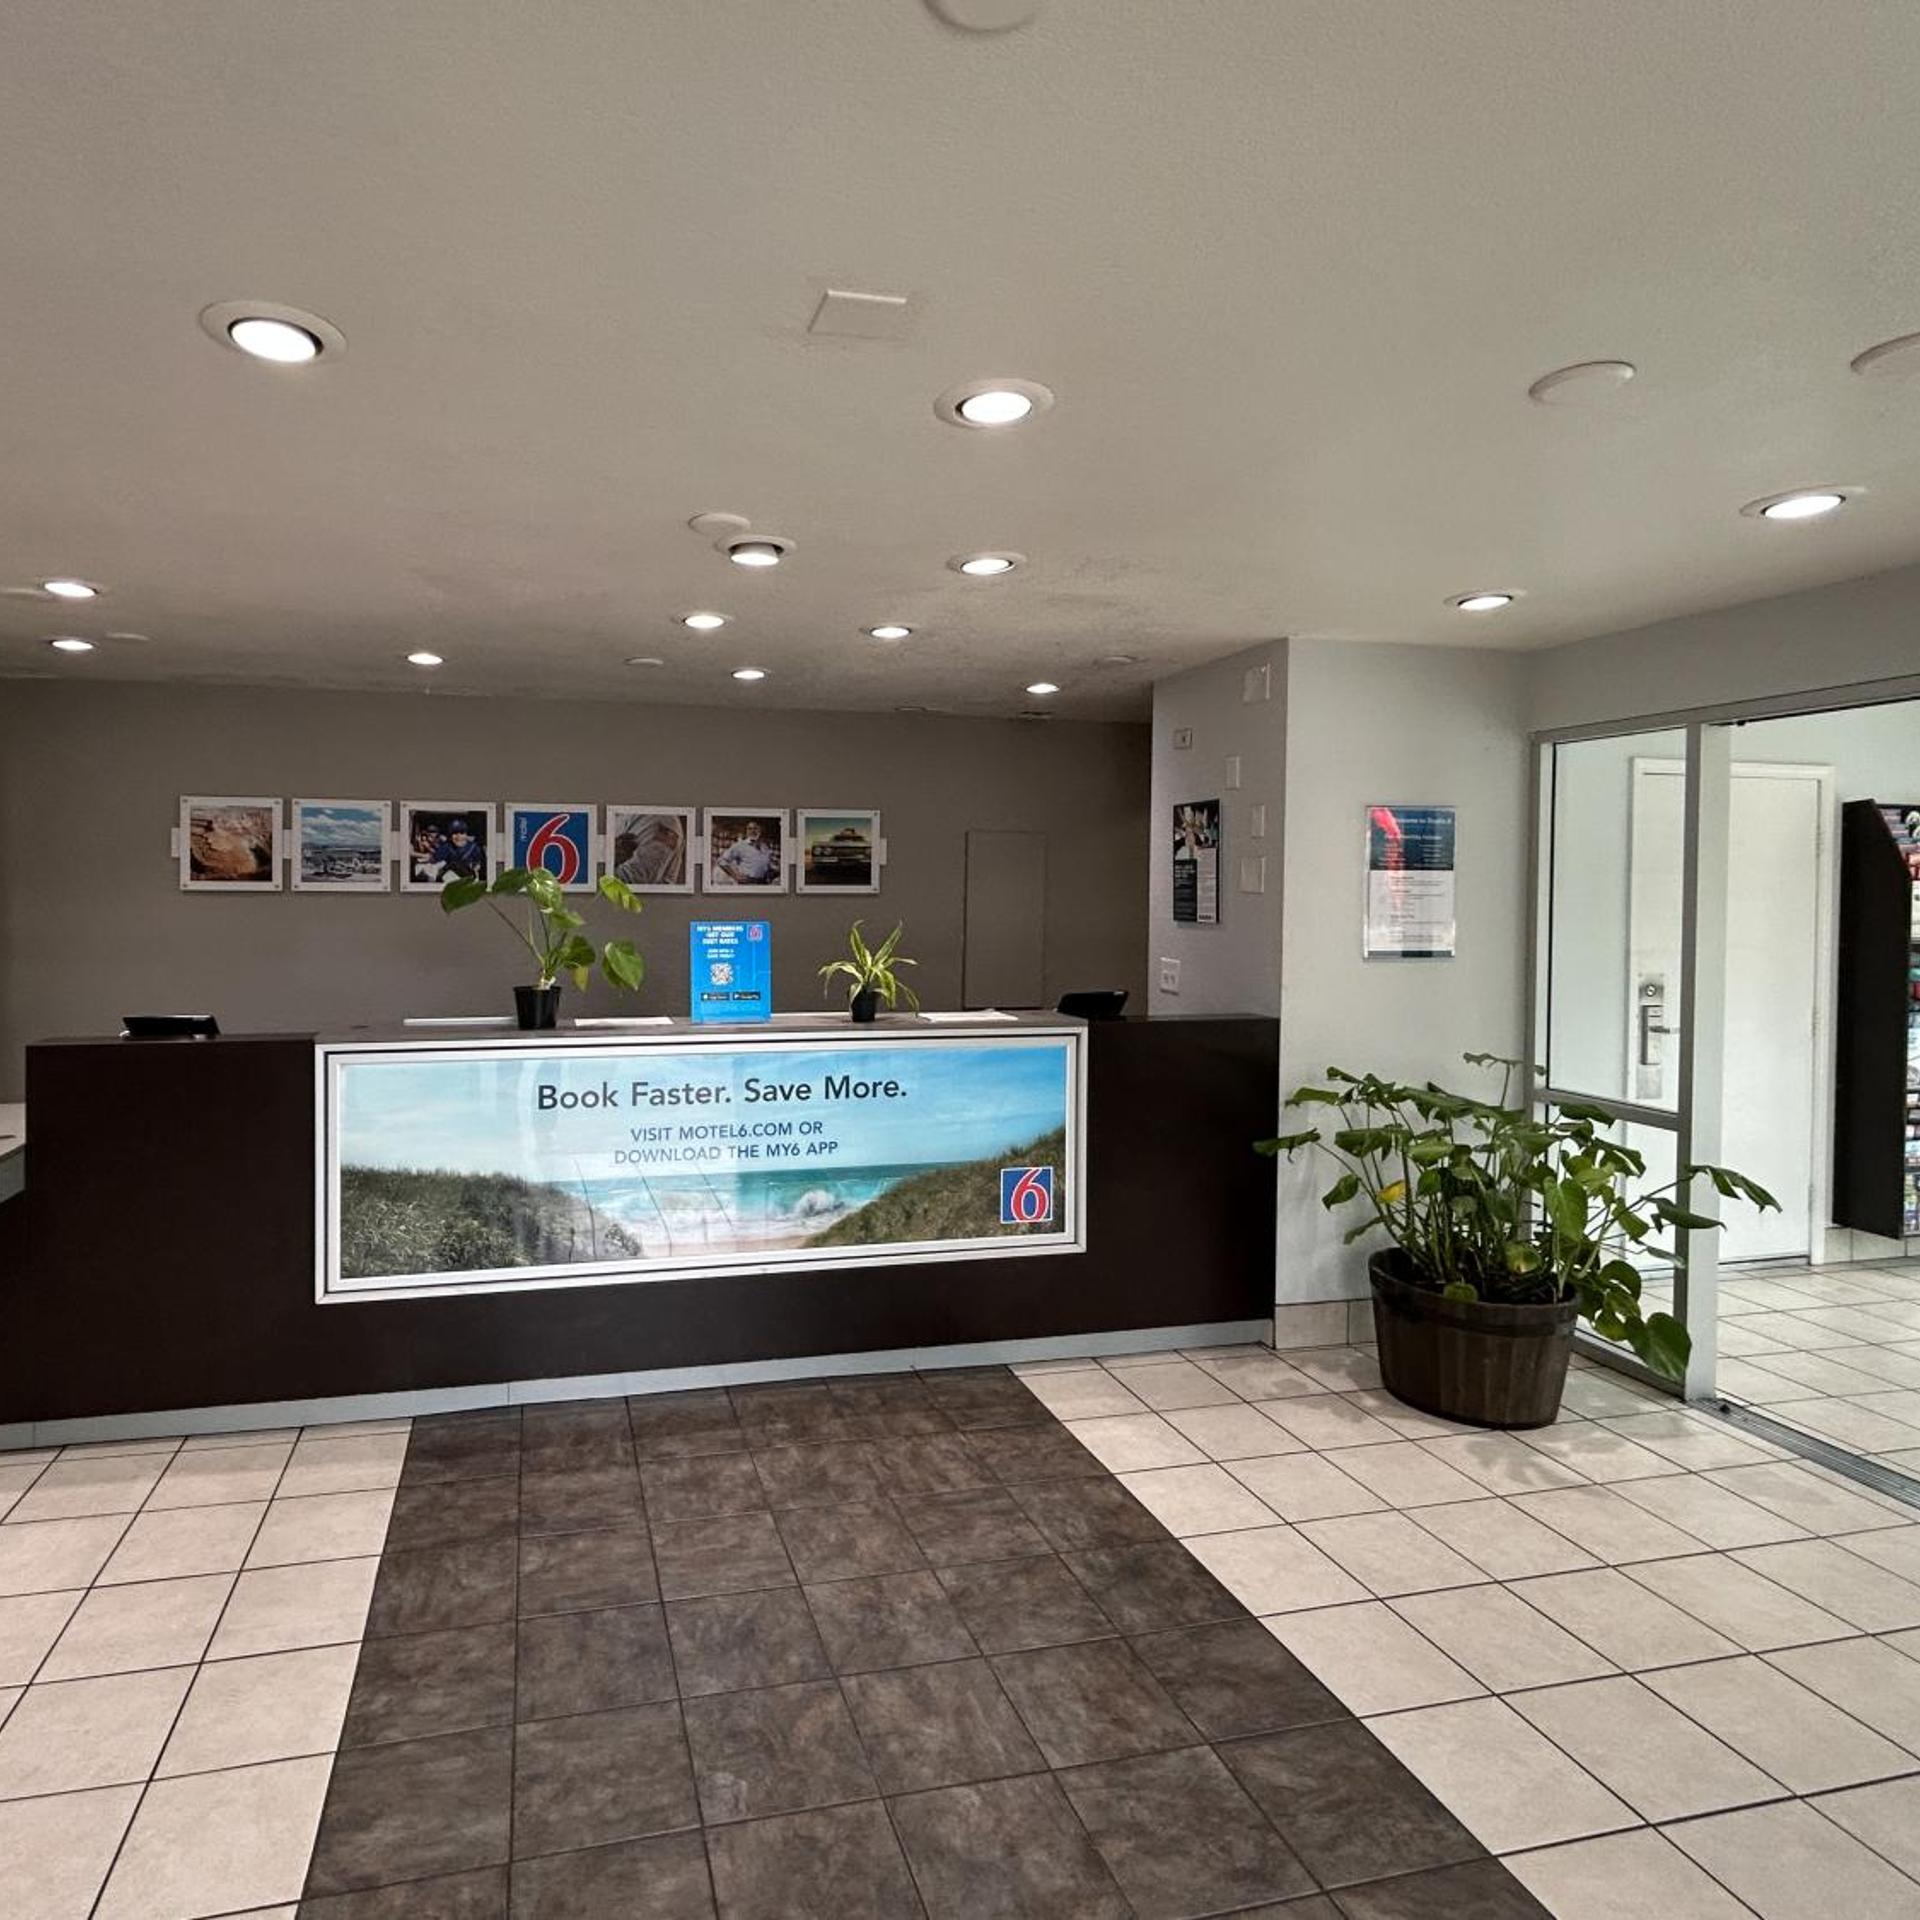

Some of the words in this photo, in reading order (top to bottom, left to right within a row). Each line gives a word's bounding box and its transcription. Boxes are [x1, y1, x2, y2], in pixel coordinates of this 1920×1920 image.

[526, 814, 579, 886] 6
[537, 1081, 619, 1111] Book
[631, 1081, 731, 1107] Faster.
[744, 1078, 812, 1103] Save
[824, 1075, 907, 1101] More.
[631, 1127, 673, 1142] VISIT
[680, 1122, 793, 1141] MOTEL6.COM
[799, 1121, 823, 1136] OR
[614, 1146, 721, 1165] DOWNLOAD
[728, 1144, 759, 1159] THE
[766, 1142, 800, 1157] MY6
[806, 1140, 839, 1155] APP
[1011, 1167, 1050, 1223] 6
